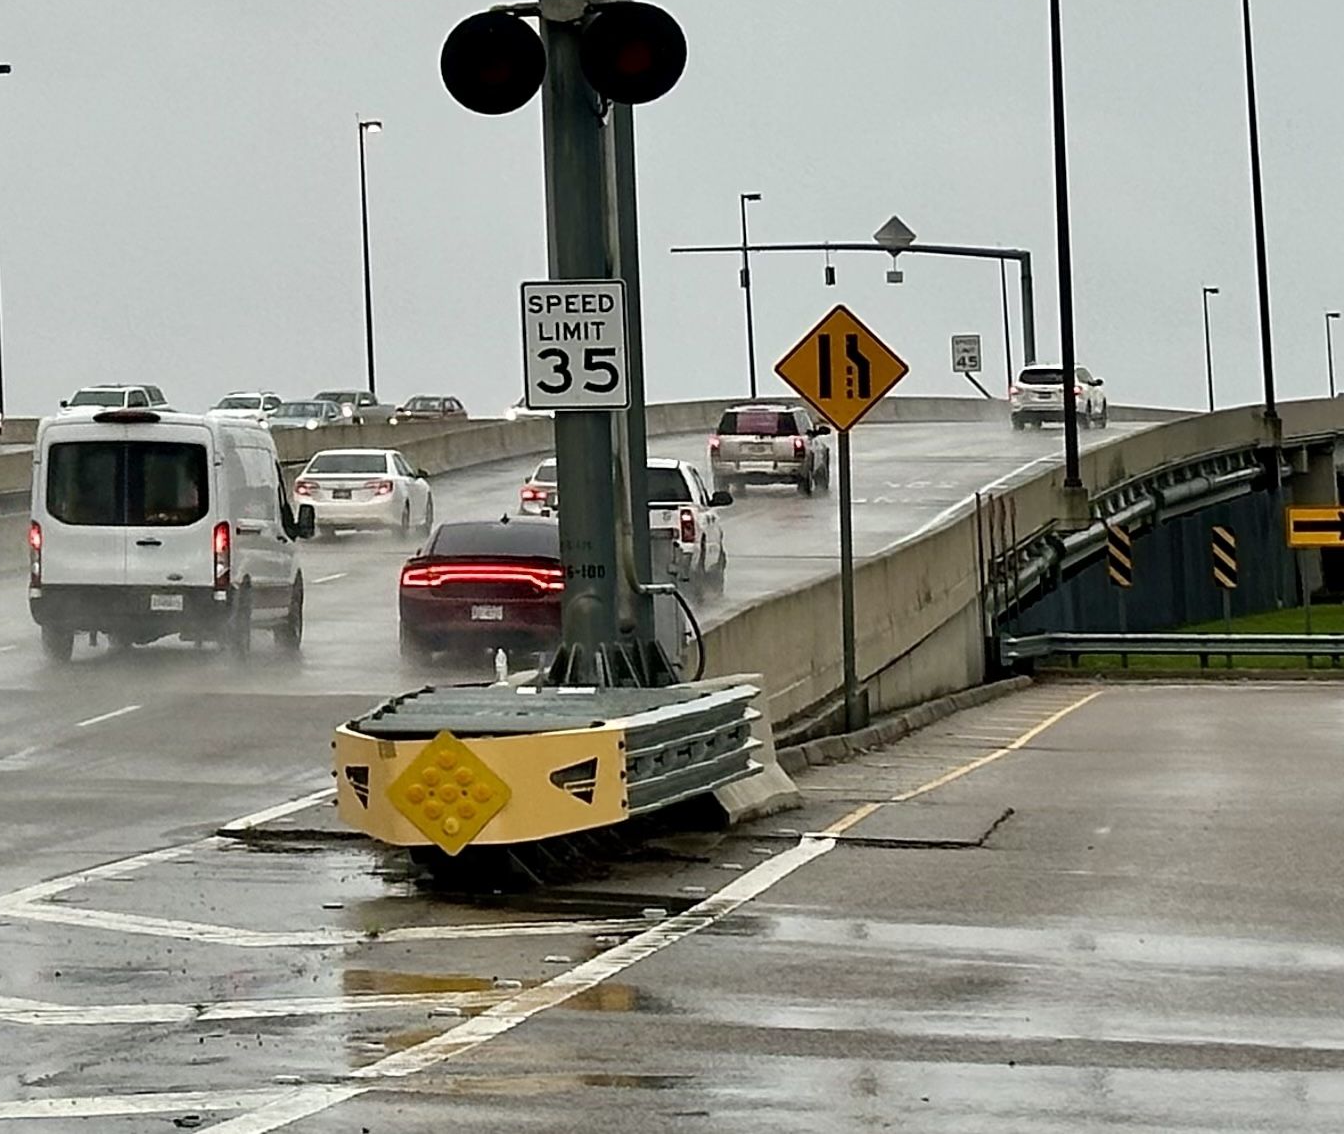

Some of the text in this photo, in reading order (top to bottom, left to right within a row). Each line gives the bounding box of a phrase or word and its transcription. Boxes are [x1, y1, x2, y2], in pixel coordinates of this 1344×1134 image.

[528, 293, 615, 314] SPEED
[538, 321, 606, 341] LIMIT
[536, 347, 620, 394] 35
[956, 355, 978, 368] 45
